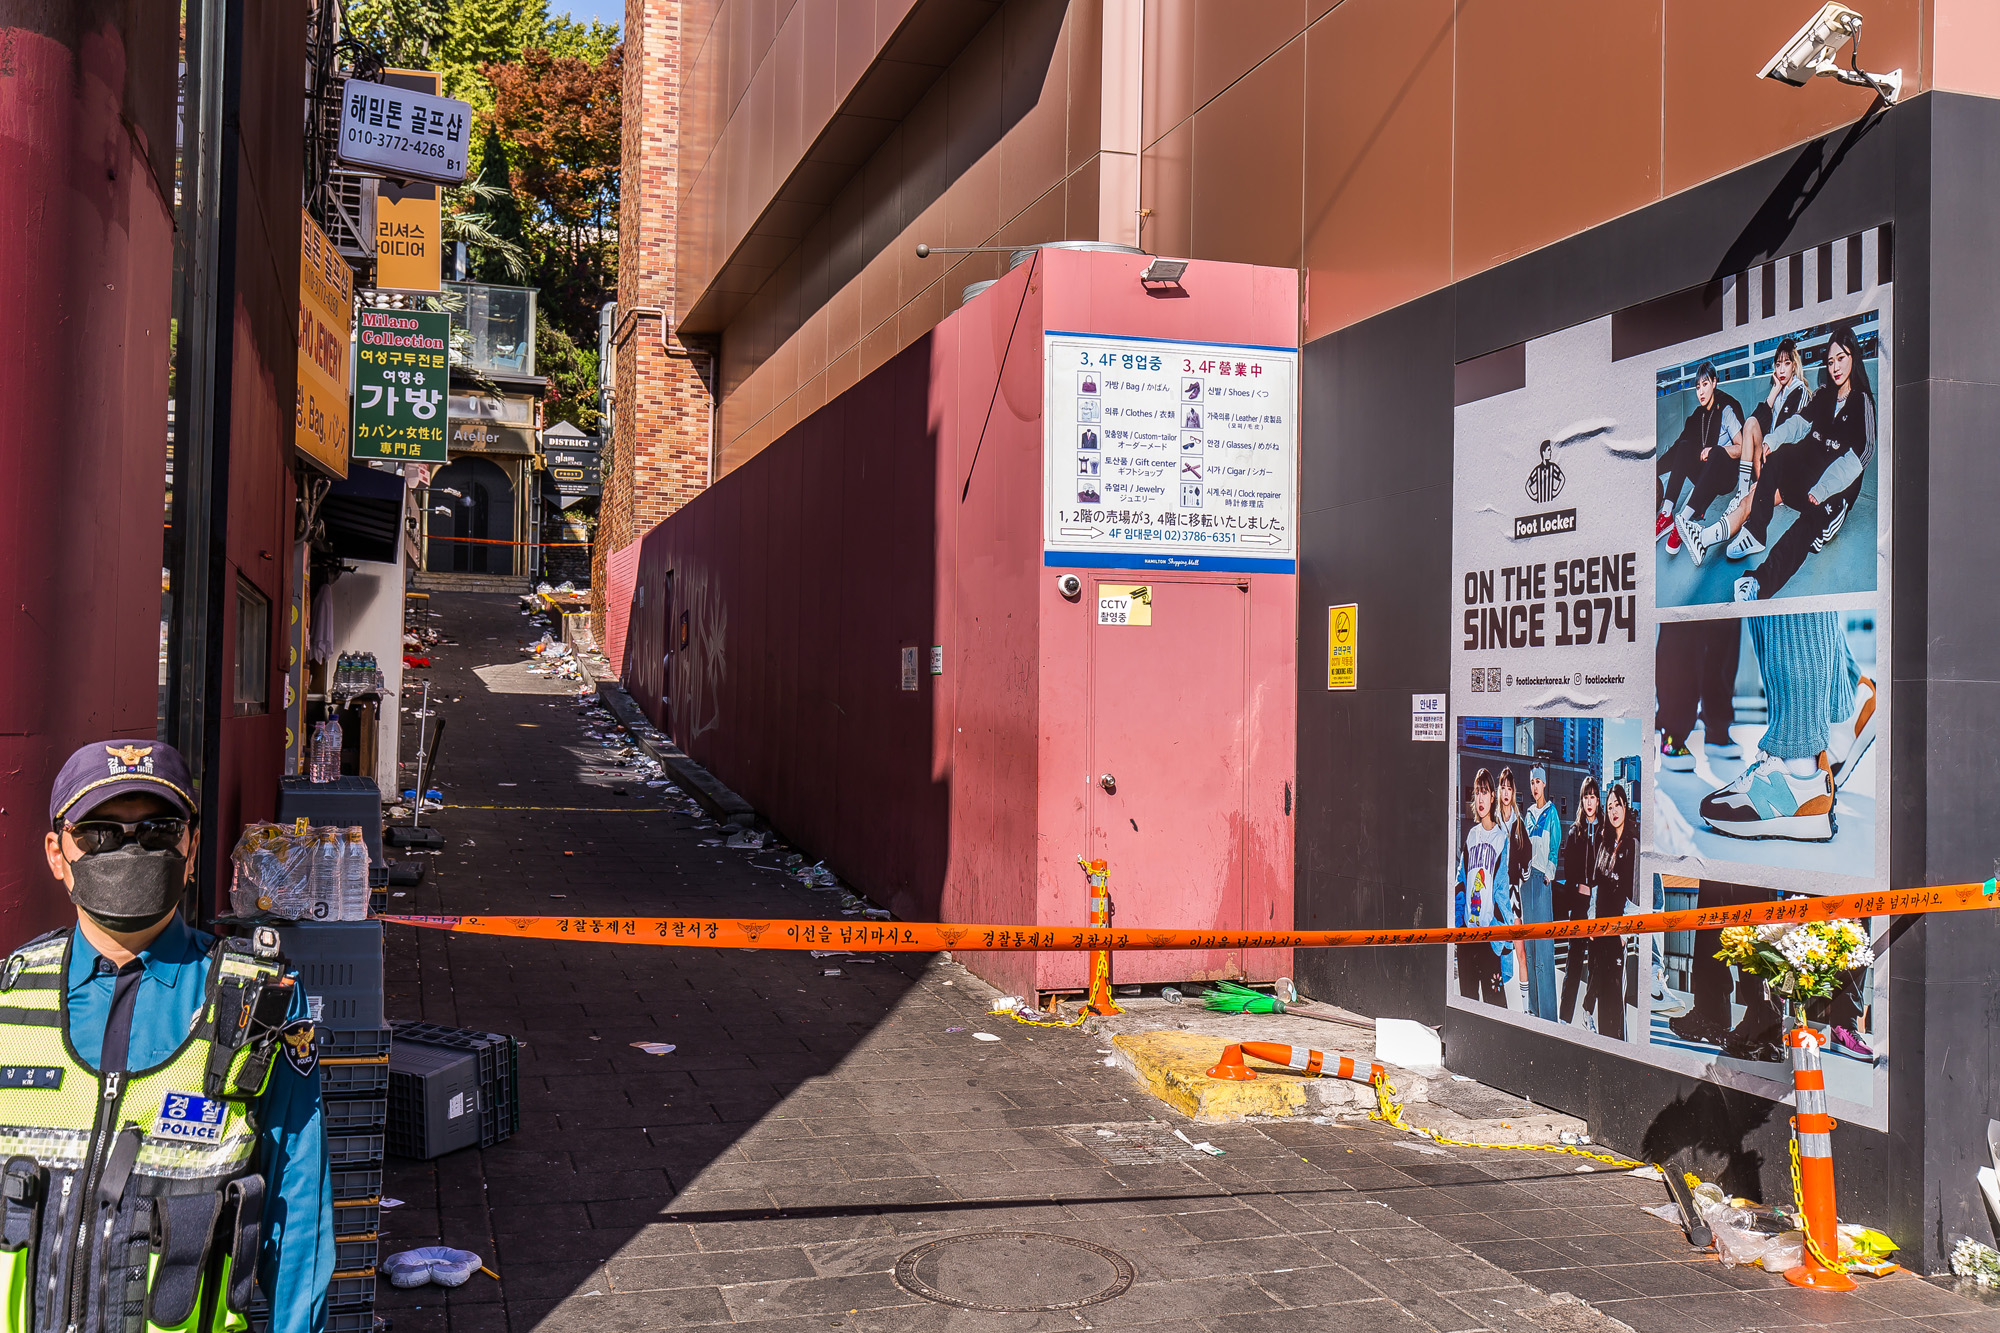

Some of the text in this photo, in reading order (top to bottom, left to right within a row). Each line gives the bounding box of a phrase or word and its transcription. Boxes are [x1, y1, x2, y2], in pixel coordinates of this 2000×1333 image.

[350, 94, 463, 142] 해밀톤 골프샵
[348, 128, 445, 158] 010-3772-4268
[447, 159, 460, 171] B1
[377, 221, 425, 238] 리셔스
[324, 242, 349, 305] 골프샵
[361, 313, 419, 330] Milano
[361, 330, 444, 350] Collection
[360, 350, 445, 368] 여성구두전문
[1080, 352, 1162, 372] 3, 4F 영업중
[1182, 358, 1195, 374] 3,
[1198, 360, 1216, 374] 4F
[382, 370, 426, 386] 여행용
[1104, 381, 1119, 390] 가방
[1126, 382, 1140, 392] Bag
[1207, 387, 1222, 396] 신발
[1228, 388, 1250, 397] Shoes
[1256, 390, 1269, 398] くつ
[360, 384, 443, 420] 가방
[1104, 407, 1119, 416] 의류
[1125, 408, 1153, 418] Clothes
[1235, 413, 1259, 423] Leather
[309, 394, 326, 446] Bag,
[453, 430, 500, 444] Atelier
[548, 437, 590, 447] DISTRICT
[1134, 431, 1178, 441] Custom-tailor
[1207, 439, 1220, 448] 안경
[1226, 440, 1252, 450] Glasses
[555, 452, 575, 464] glam
[1104, 457, 1128, 466] 토산품
[1135, 458, 1150, 467] Gift
[1151, 459, 1177, 468] center
[1206, 465, 1221, 474] 시가
[1226, 467, 1246, 476] Cigar
[1252, 468, 1273, 476] シガー
[1104, 483, 1128, 493] 쥬얼리
[1135, 485, 1165, 495] Jewelry
[1238, 489, 1256, 498] Clock
[1256, 491, 1282, 500] repairer
[1516, 514, 1575, 536] Foot Locker
[1108, 528, 1122, 538] 4F
[1124, 528, 1162, 541] 임대문의
[1464, 551, 1636, 606] ON THE SCENE
[1100, 599, 1128, 609] CCTV
[1100, 612, 1127, 623] 촬영중
[1463, 595, 1636, 651] SINCE 1974
[1515, 674, 1626, 686] footlockerkorea.kr footlockerkr
[1419, 699, 1438, 710] 안내문
[556, 919, 636, 936] 경찰통제선
[654, 921, 720, 939] 경찰서장
[787, 924, 832, 944] 이선을
[840, 925, 919, 946] 넘지마시오.
[982, 930, 1055, 948] 경찰통제선
[1071, 933, 1130, 948] 경찰서장
[1545, 924, 1581, 938] 이선을
[1696, 908, 1753, 927] 경찰통제선
[1763, 903, 1809, 921] 경찰서장
[1853, 896, 1886, 914] 이선을
[1890, 892, 1943, 911] 넘지마시오.
[167, 1095, 222, 1123] 경찰
[161, 1122, 217, 1138] POLICE
